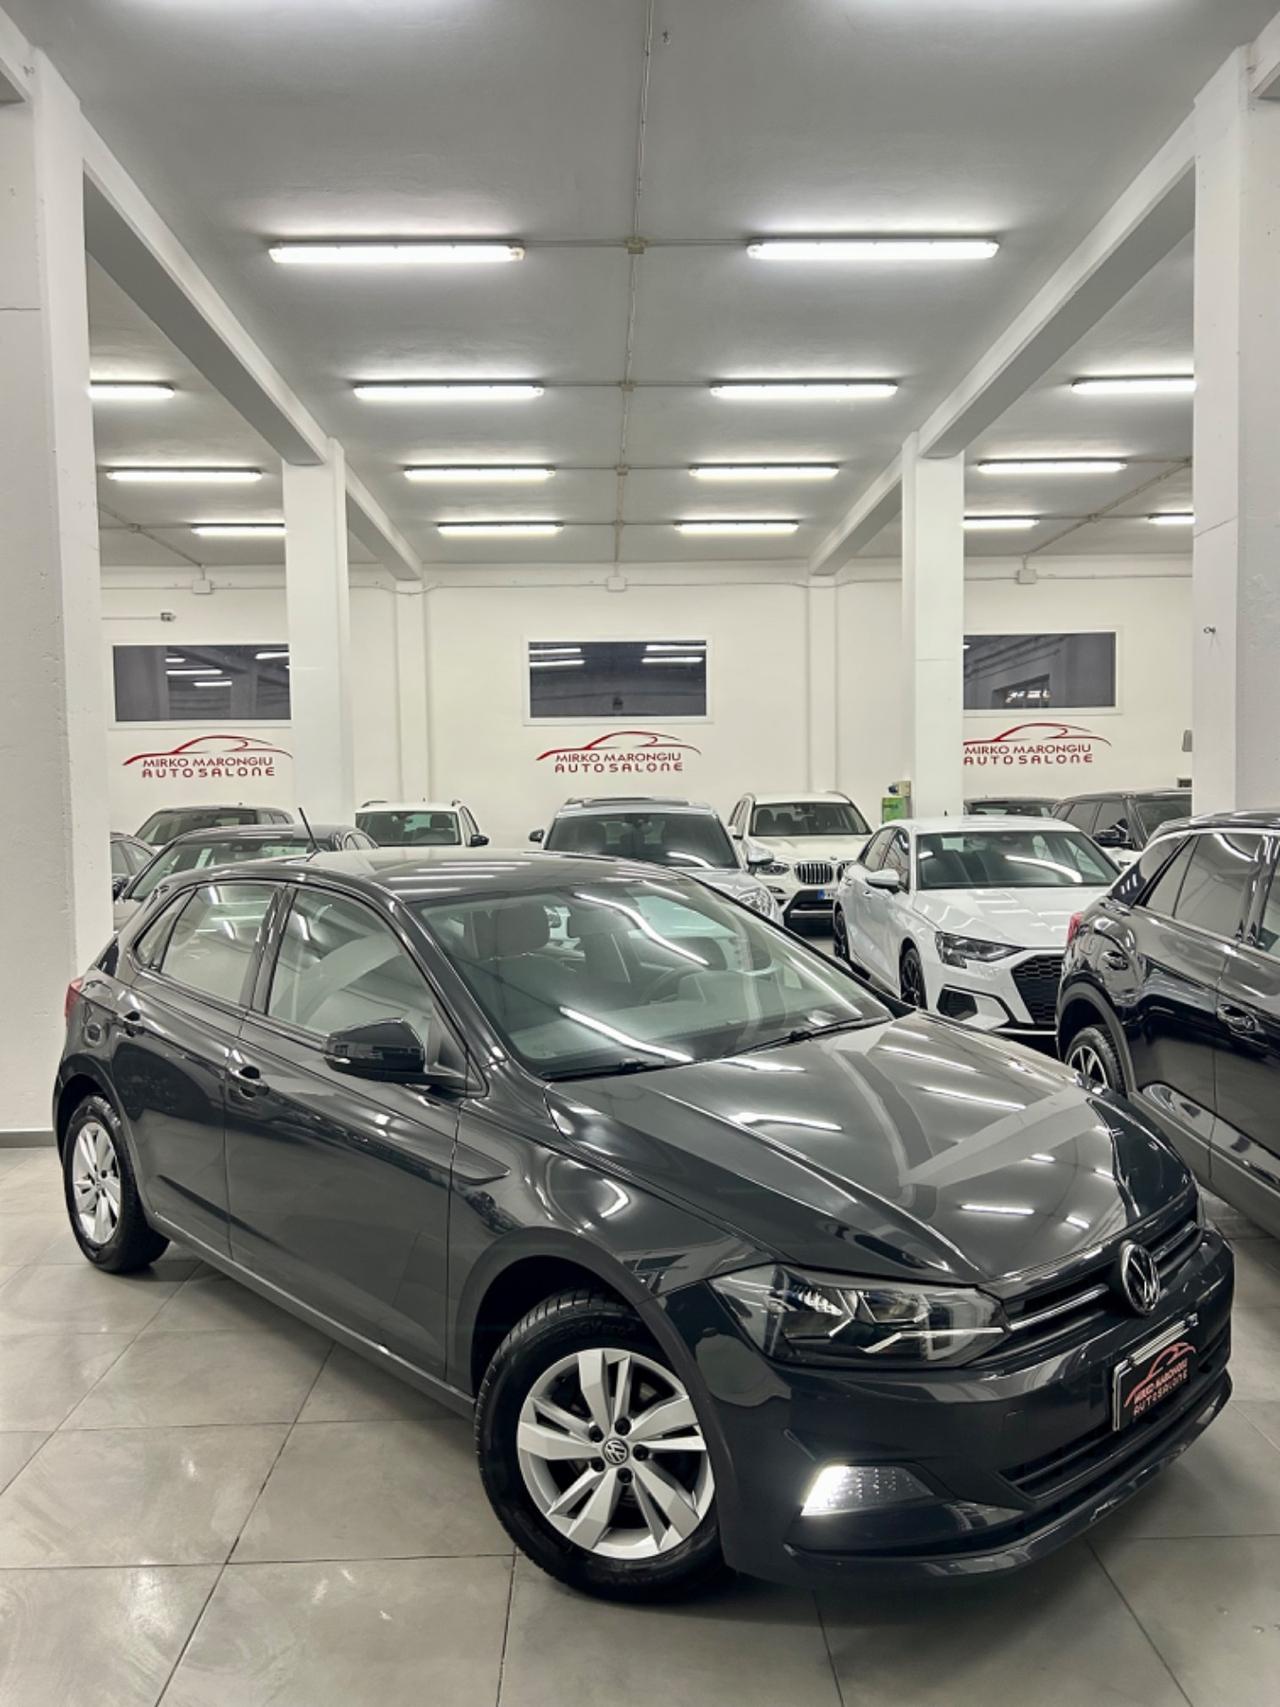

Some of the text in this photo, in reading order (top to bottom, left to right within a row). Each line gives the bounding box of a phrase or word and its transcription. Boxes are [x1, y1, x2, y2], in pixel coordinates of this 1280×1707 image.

[964, 744, 1091, 755] MIRKO MARONGIU
[143, 756, 273, 768] MIRKO MARONGIU
[555, 752, 682, 763] MIRKO MARONGIU
[963, 754, 1093, 765] AUTOSALONE
[142, 767, 275, 778] AUTOSALONE
[554, 762, 683, 773] AUTOSALONE
